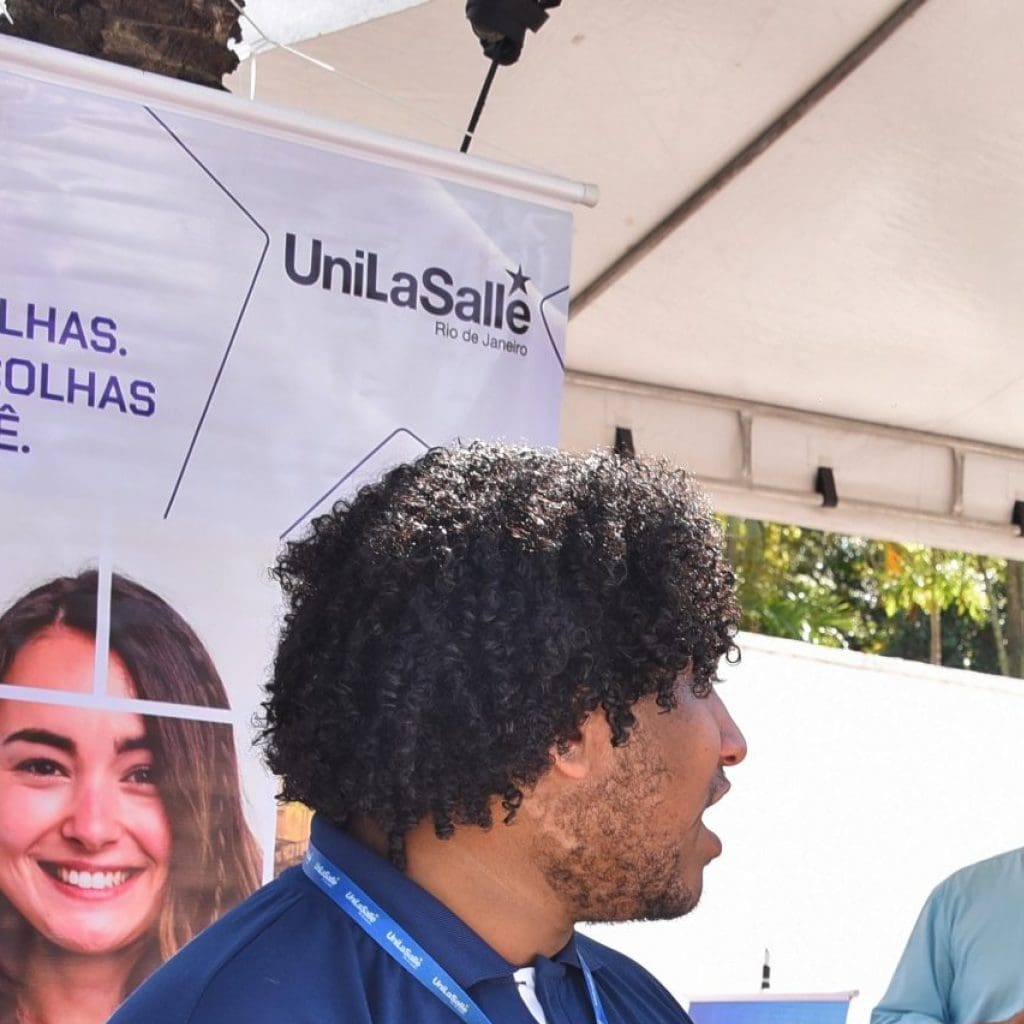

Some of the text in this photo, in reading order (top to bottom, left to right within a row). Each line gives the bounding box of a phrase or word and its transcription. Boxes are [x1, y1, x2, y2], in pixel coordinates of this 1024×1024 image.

[284, 232, 531, 335] UniLaSalle
[435, 321, 528, 356] Rio de Janeiro
[0, 358, 156, 417] OLHAS
